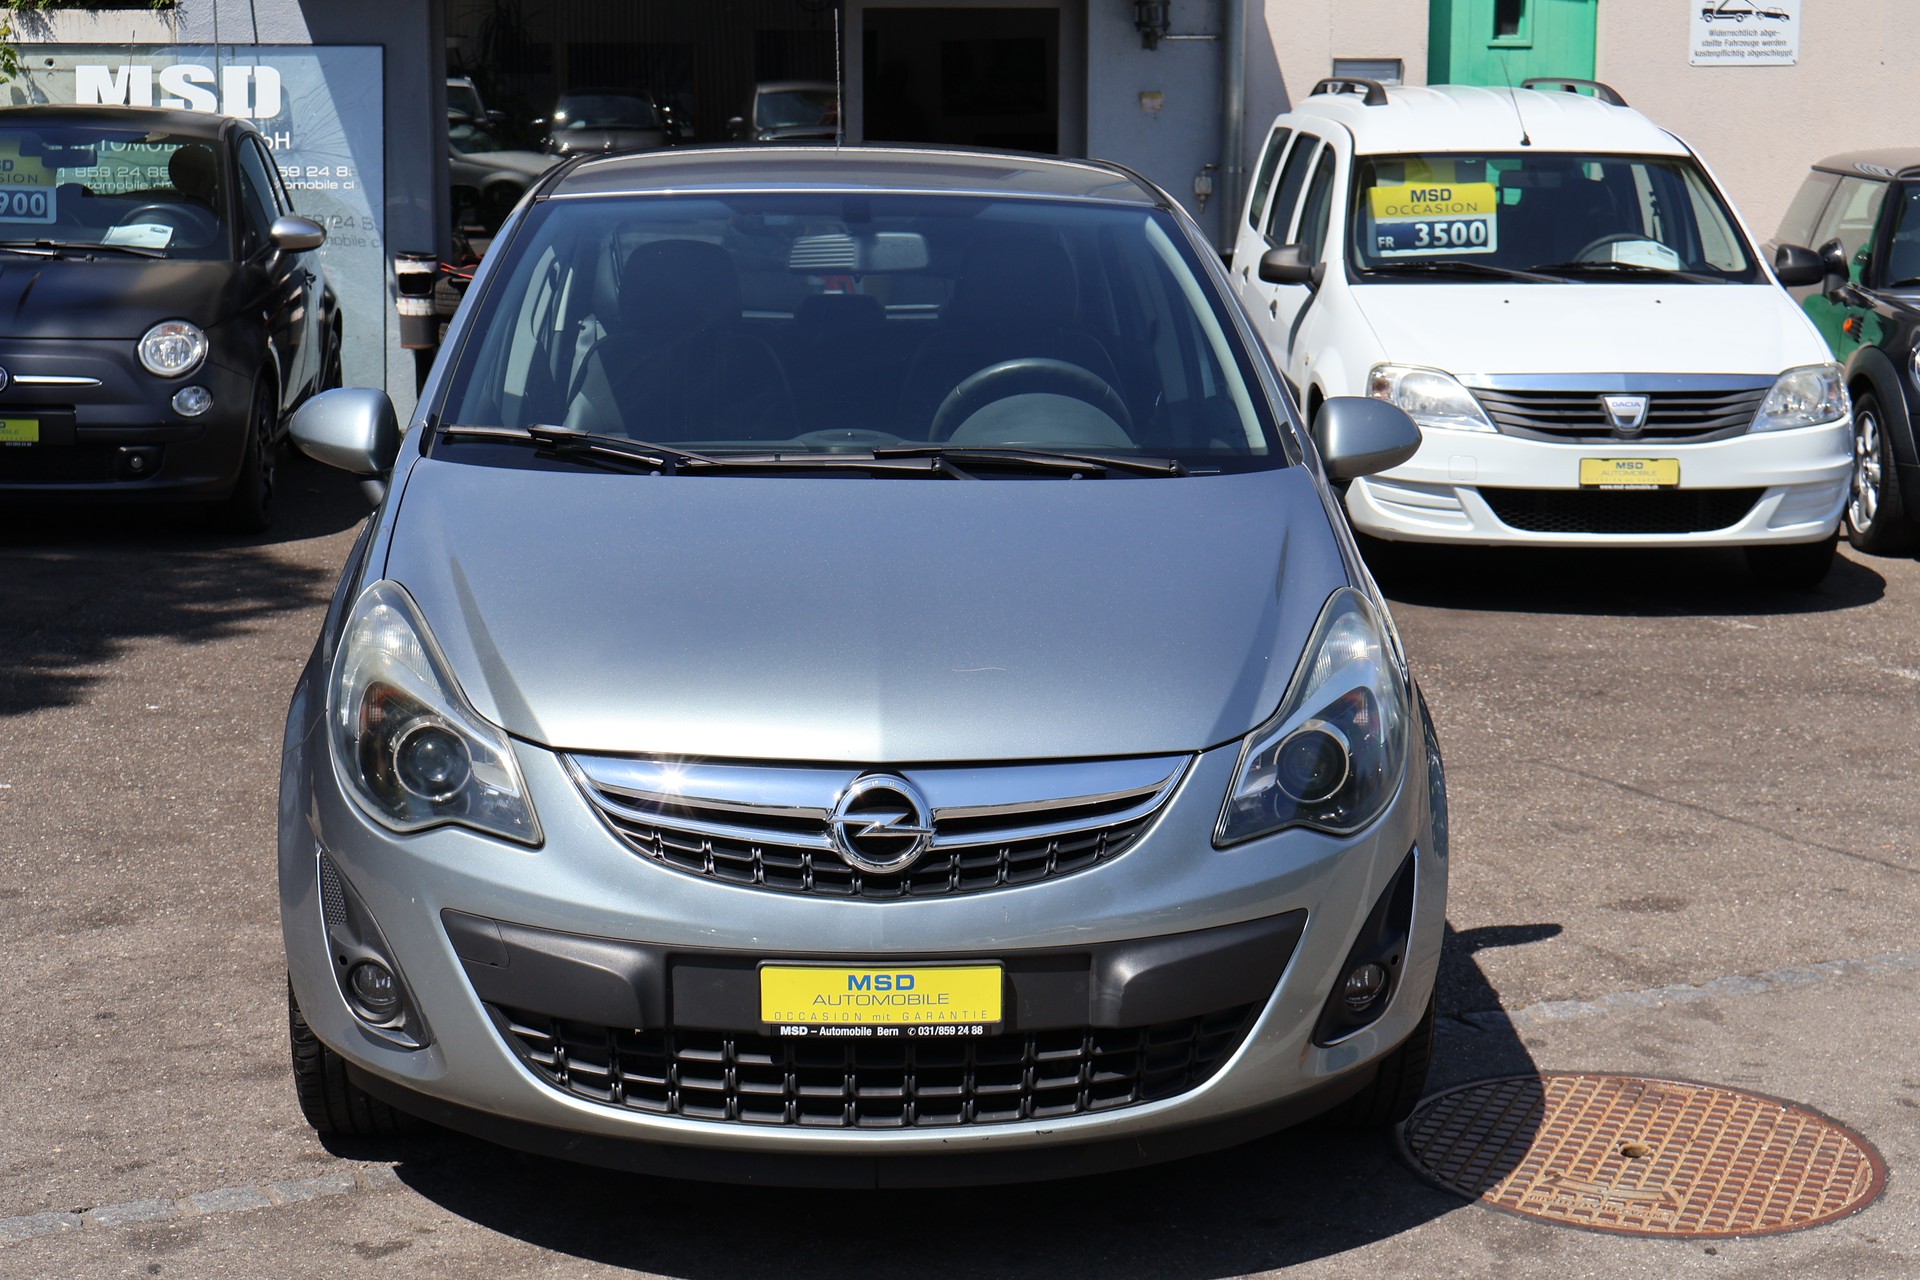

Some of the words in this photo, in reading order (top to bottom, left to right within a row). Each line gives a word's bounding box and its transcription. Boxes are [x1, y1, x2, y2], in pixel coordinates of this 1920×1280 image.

[75, 64, 281, 119] MSD
[117, 166, 141, 178] 24
[278, 166, 300, 178] 59
[306, 166, 330, 178] 24
[1410, 188, 1452, 203] MSD
[1385, 203, 1478, 216] OCCASION
[1377, 236, 1395, 248] FR
[1414, 221, 1486, 247] 3500
[1615, 462, 1643, 470] MSD
[847, 974, 915, 991] MSD
[812, 993, 949, 1006] AUTOMOBILE
[774, 1011, 862, 1021] OCCASION
[872, 1012, 891, 1021] mit
[902, 1010, 988, 1021] GARANTIE
[780, 1026, 808, 1036] MSD
[819, 1026, 872, 1036] Automobile
[877, 1026, 899, 1036] Bern
[918, 1026, 956, 1036] 031/859
[957, 1026, 970, 1035] 24
[971, 1026, 983, 1035] 88
